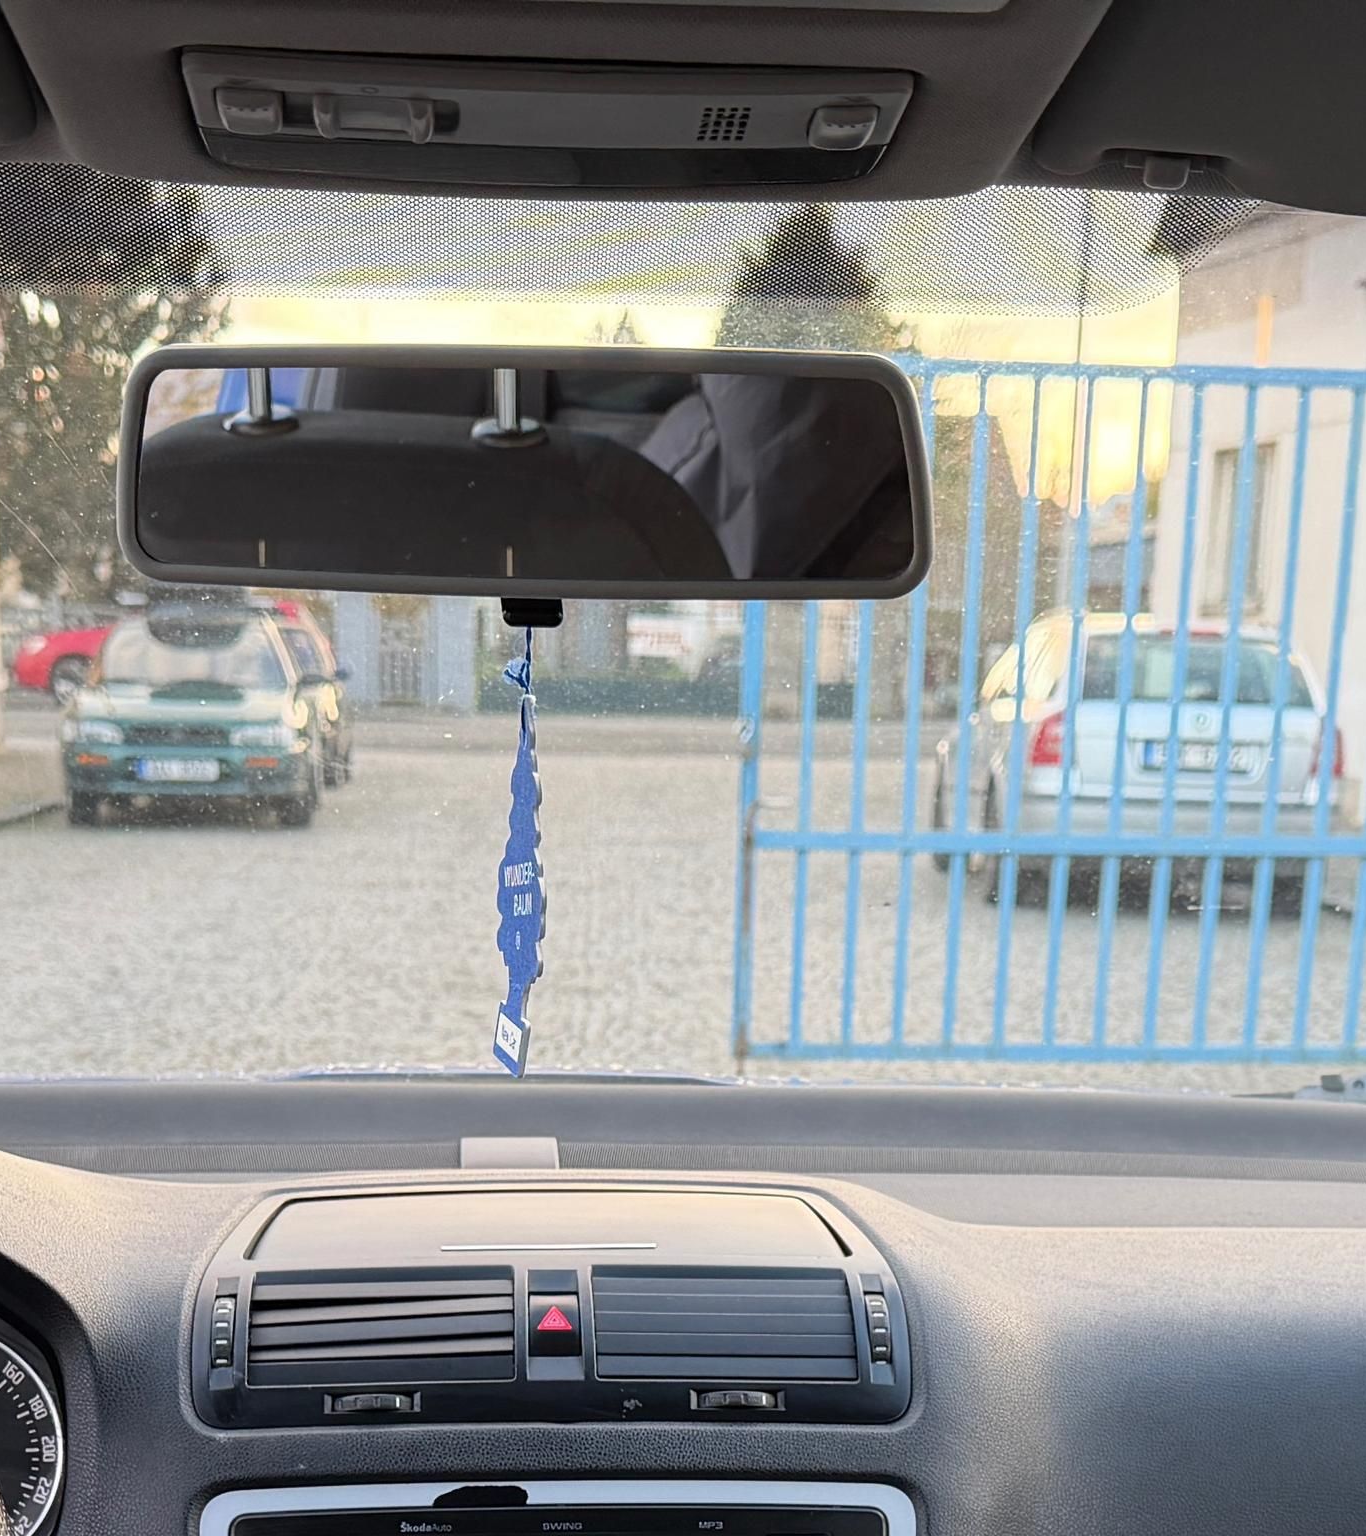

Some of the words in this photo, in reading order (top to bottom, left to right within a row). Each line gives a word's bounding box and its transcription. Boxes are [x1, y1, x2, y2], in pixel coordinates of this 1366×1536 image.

[2, 1360, 25, 1385] 160
[28, 1393, 49, 1421] 180
[41, 1434, 56, 1463] 200
[32, 1476, 53, 1506] 220
[698, 1521, 724, 1530] MP3
